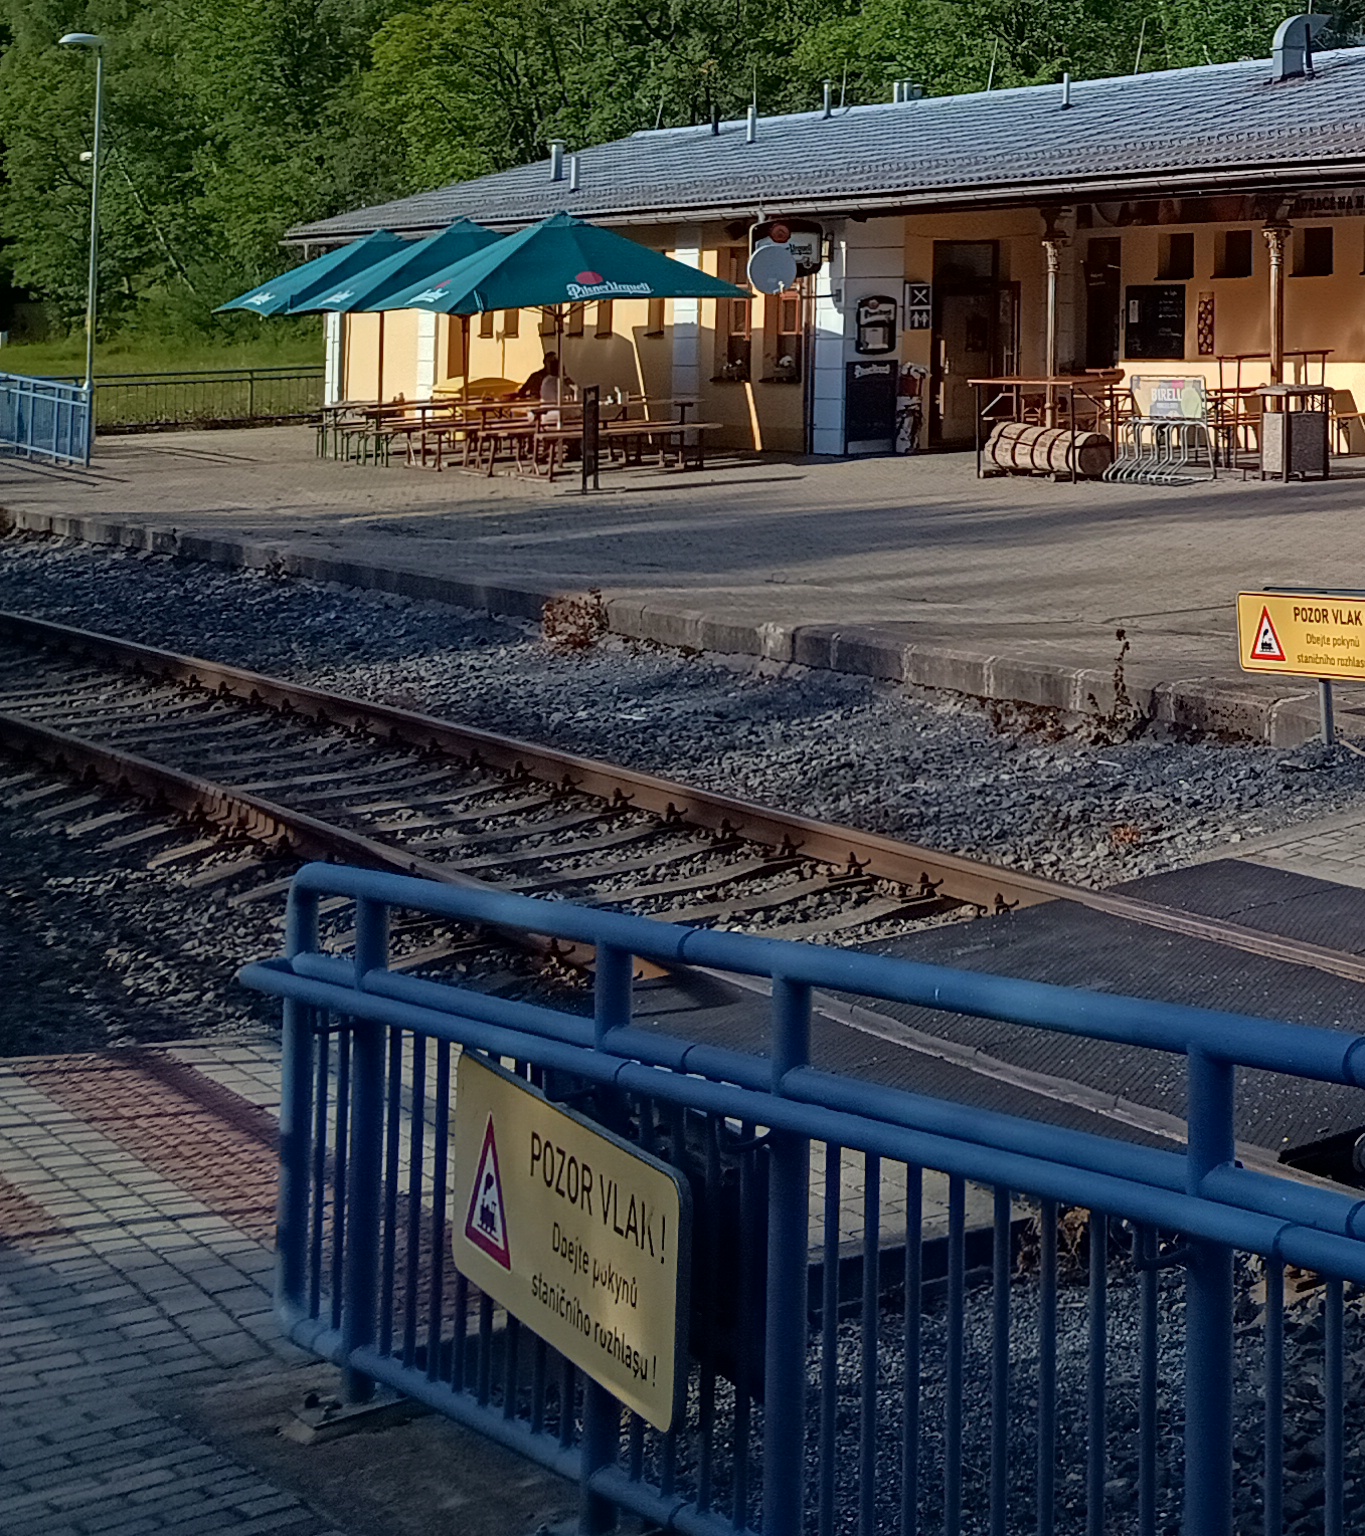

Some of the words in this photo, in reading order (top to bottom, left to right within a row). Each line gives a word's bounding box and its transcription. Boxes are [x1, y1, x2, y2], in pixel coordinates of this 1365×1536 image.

[566, 281, 609, 300] Pilsner
[1151, 387, 1182, 402] BIRELL
[1293, 606, 1329, 625] POZOR
[1332, 609, 1363, 626] VLAK
[1306, 633, 1330, 647] Dbejte
[1332, 635, 1360, 649] pokynů
[1297, 653, 1336, 666] staničního
[530, 1131, 593, 1216] POZOR
[600, 1174, 655, 1258] VLAK
[660, 1215, 666, 1264] !
[552, 1222, 589, 1276] Dbejte
[593, 1257, 638, 1309] pokynů
[531, 1273, 591, 1337] staničního
[594, 1321, 649, 1383] rozhlasu
[652, 1355, 657, 1387] !
